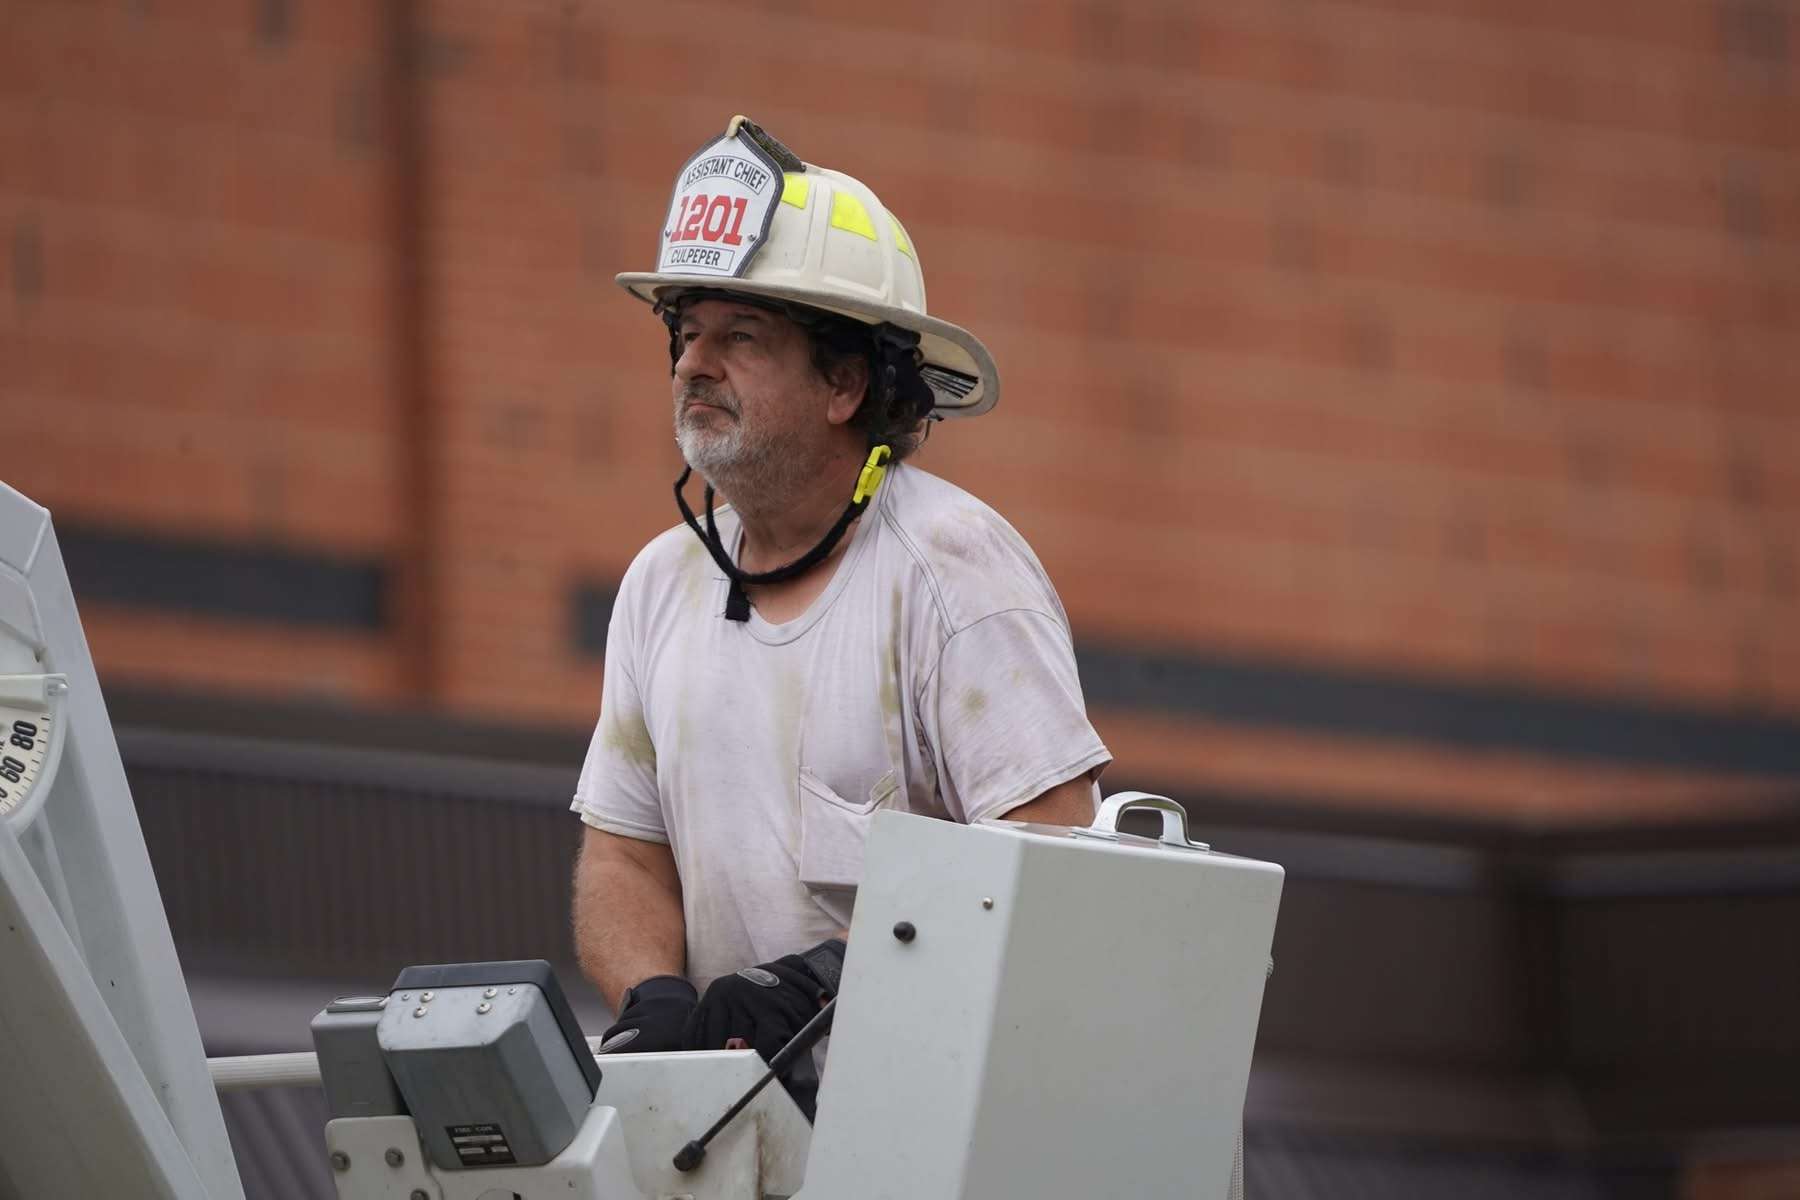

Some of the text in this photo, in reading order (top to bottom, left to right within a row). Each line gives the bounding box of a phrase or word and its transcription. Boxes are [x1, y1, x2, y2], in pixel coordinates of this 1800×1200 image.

[686, 157, 767, 191] ASSISTANT CHIEF
[670, 194, 748, 246] 1201
[671, 249, 721, 266] CULPEPER
[10, 720, 37, 751] 80
[0, 755, 26, 783] 60
